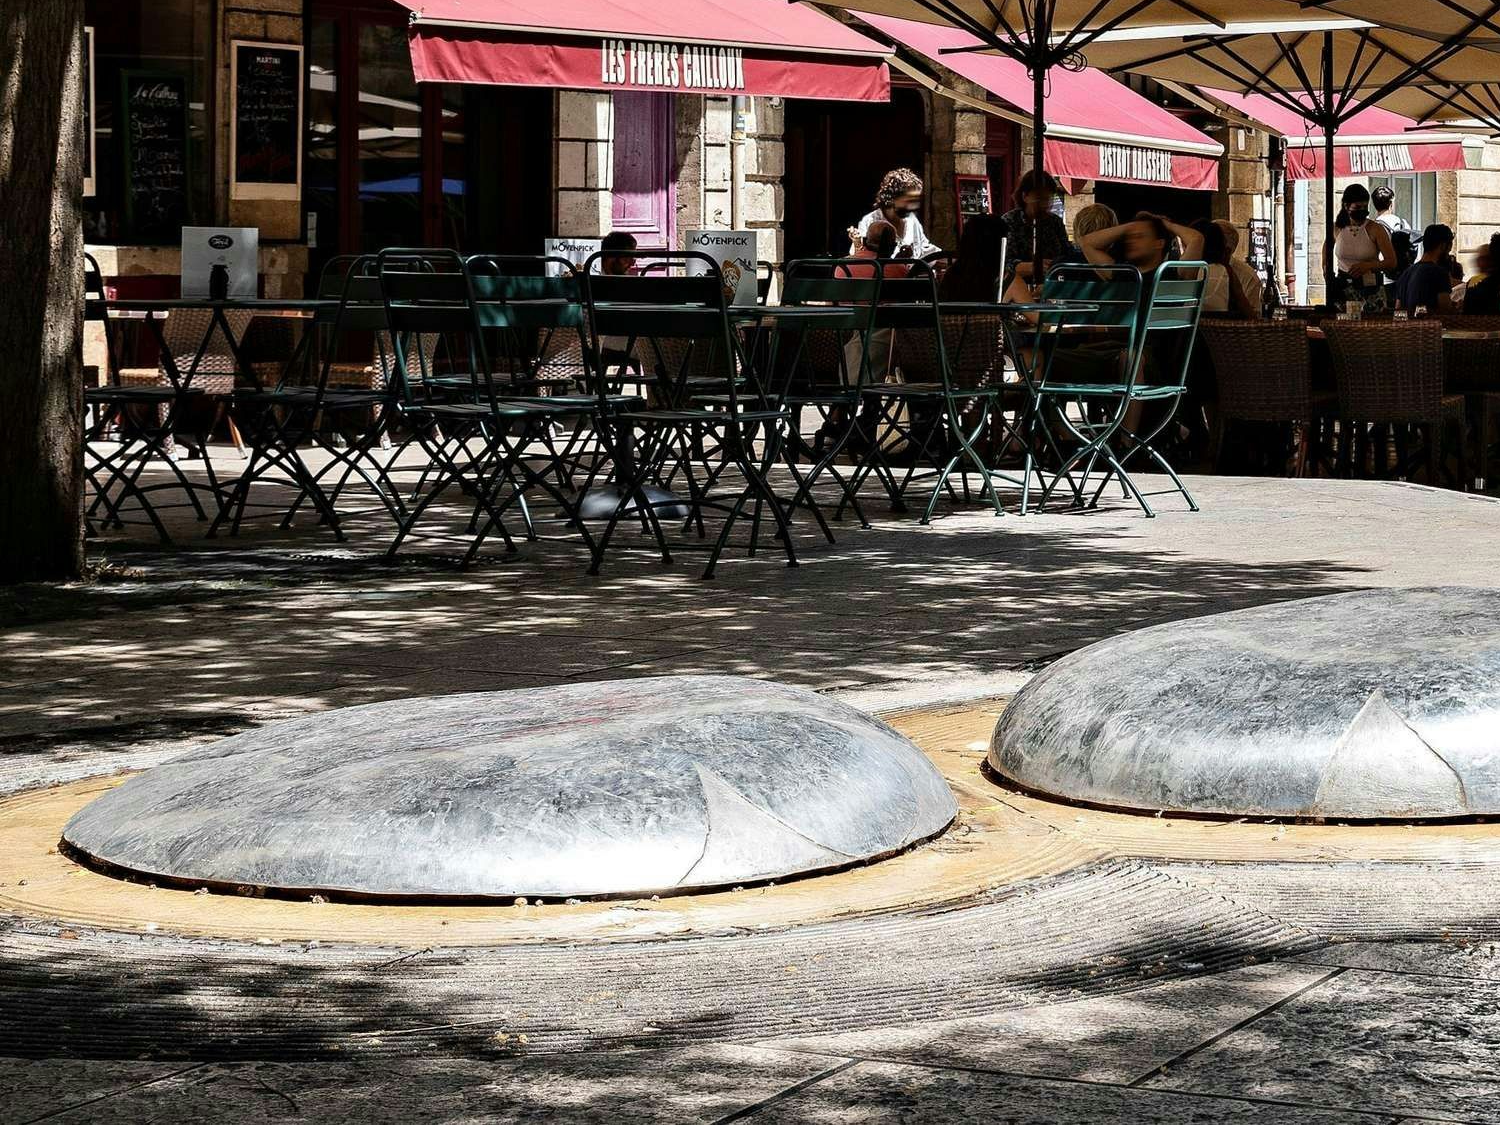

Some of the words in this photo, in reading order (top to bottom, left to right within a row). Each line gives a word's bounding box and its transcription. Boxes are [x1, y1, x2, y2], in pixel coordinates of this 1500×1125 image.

[256, 56, 281, 65] MARTINI
[602, 39, 626, 85] LES
[630, 42, 680, 88] FRERES
[683, 45, 745, 90] CAILLOUX
[1099, 143, 1130, 179] BISTROT
[1132, 147, 1172, 183] BRASSERIE
